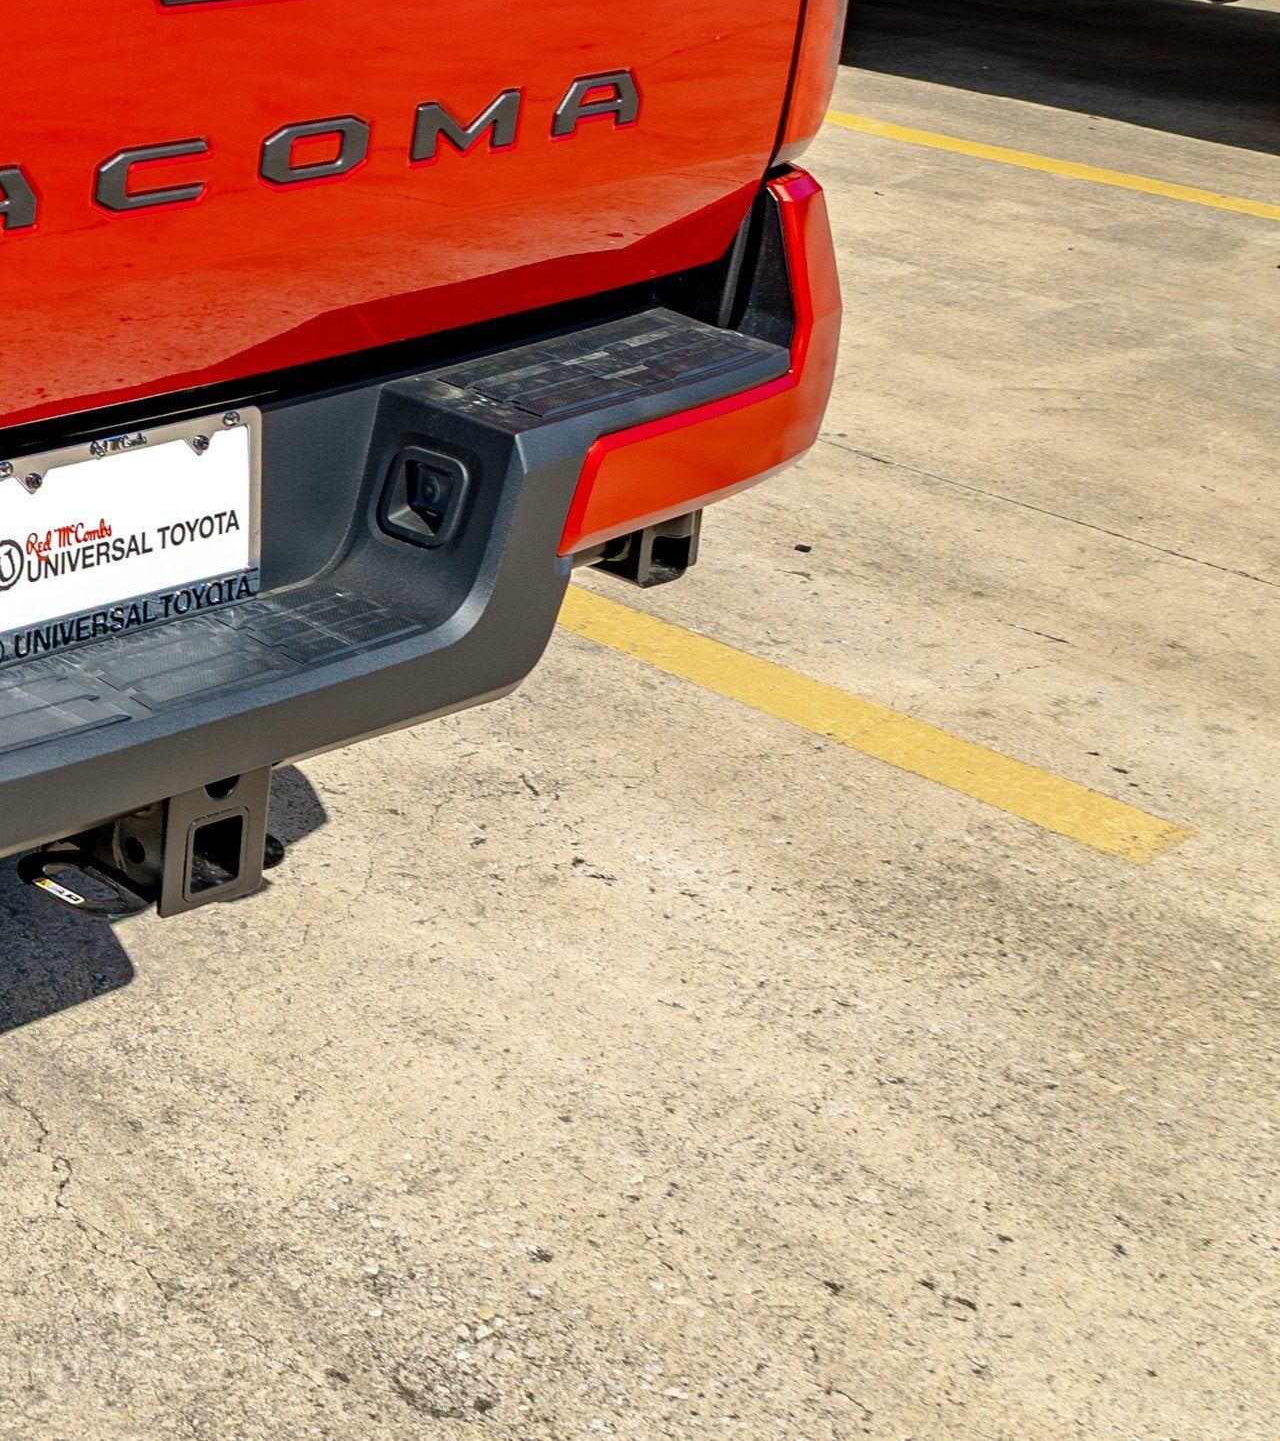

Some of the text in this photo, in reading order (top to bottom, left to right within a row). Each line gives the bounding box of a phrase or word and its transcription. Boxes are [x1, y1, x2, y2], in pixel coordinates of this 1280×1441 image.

[26, 518, 112, 560] Red McCombs
[26, 509, 240, 583] UNIVERSAL TOYOTA
[14, 575, 253, 659] UNIVERSAL TOYOTA
